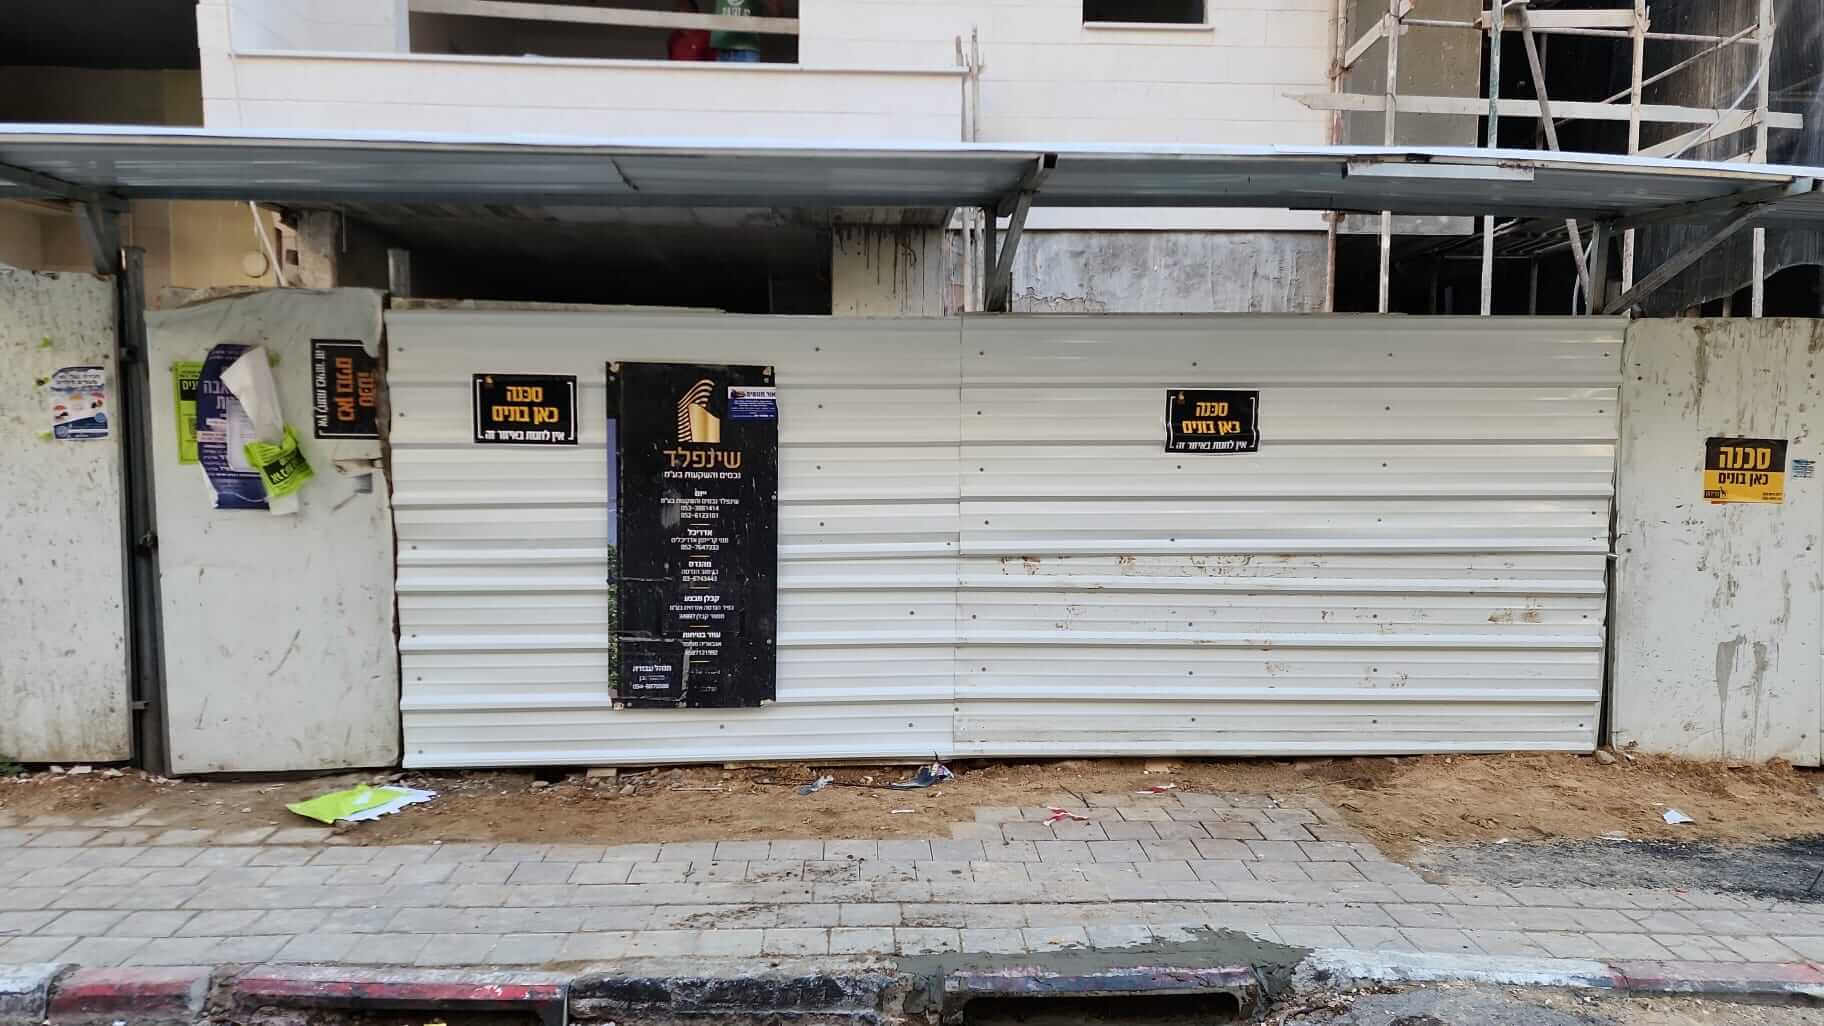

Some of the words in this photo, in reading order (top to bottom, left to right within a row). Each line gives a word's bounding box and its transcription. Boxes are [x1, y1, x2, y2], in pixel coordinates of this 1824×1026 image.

[335, 357, 353, 392] בונים
[505, 386, 545, 402] סכנה
[333, 397, 355, 422] כאן
[491, 405, 531, 422] בונים
[532, 406, 560, 425] כאן
[1195, 401, 1229, 417] סכנה
[1181, 420, 1217, 434] בונים
[663, 446, 742, 469] שינפלד
[1719, 446, 1772, 469] סכנה
[1717, 472, 1747, 485] בונים
[1749, 473, 1769, 487] כאן
